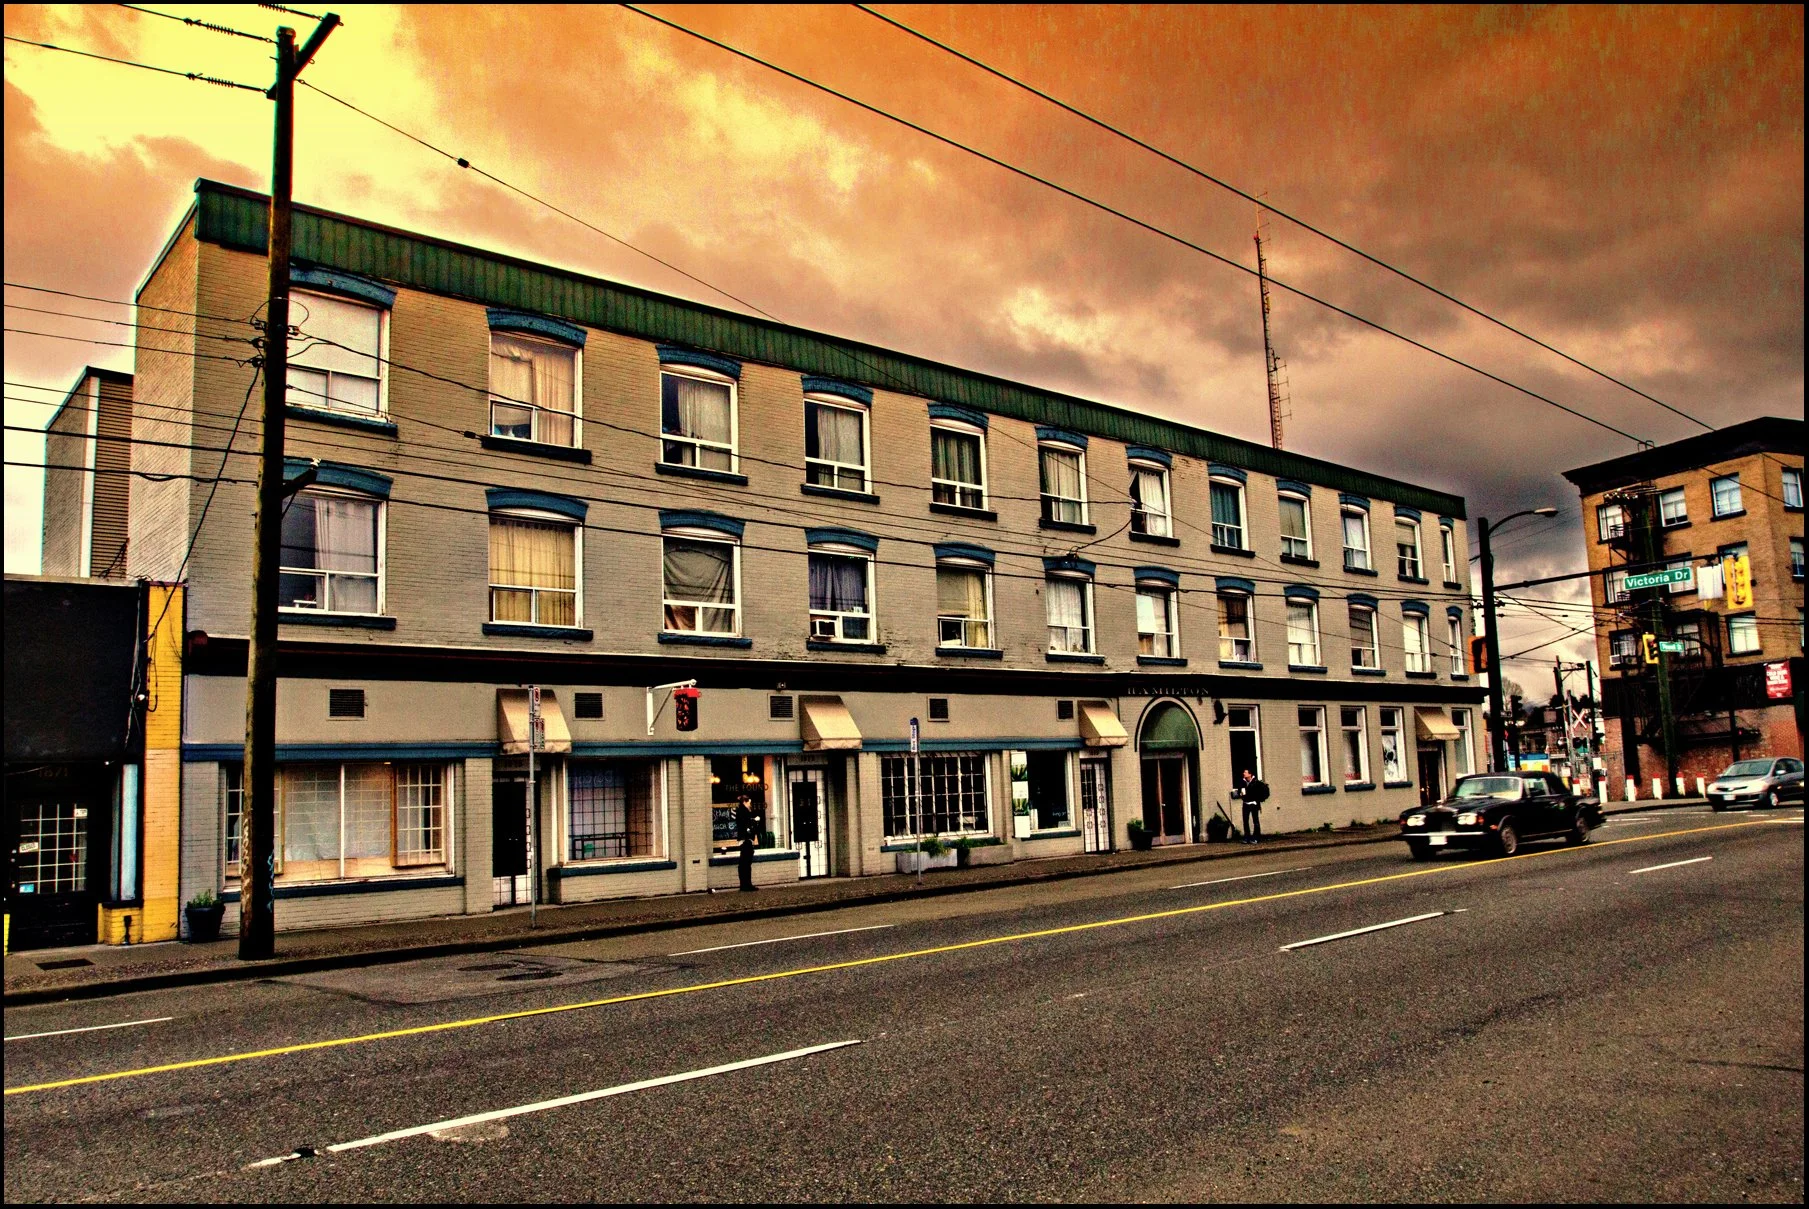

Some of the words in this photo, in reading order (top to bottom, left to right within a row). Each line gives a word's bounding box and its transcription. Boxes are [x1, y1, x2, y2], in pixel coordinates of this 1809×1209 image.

[1626, 574, 1670, 588] Victoria
[1674, 571, 1688, 581] Dr
[1127, 687, 1209, 695] HAMILTON
[742, 783, 769, 792] FOUND
